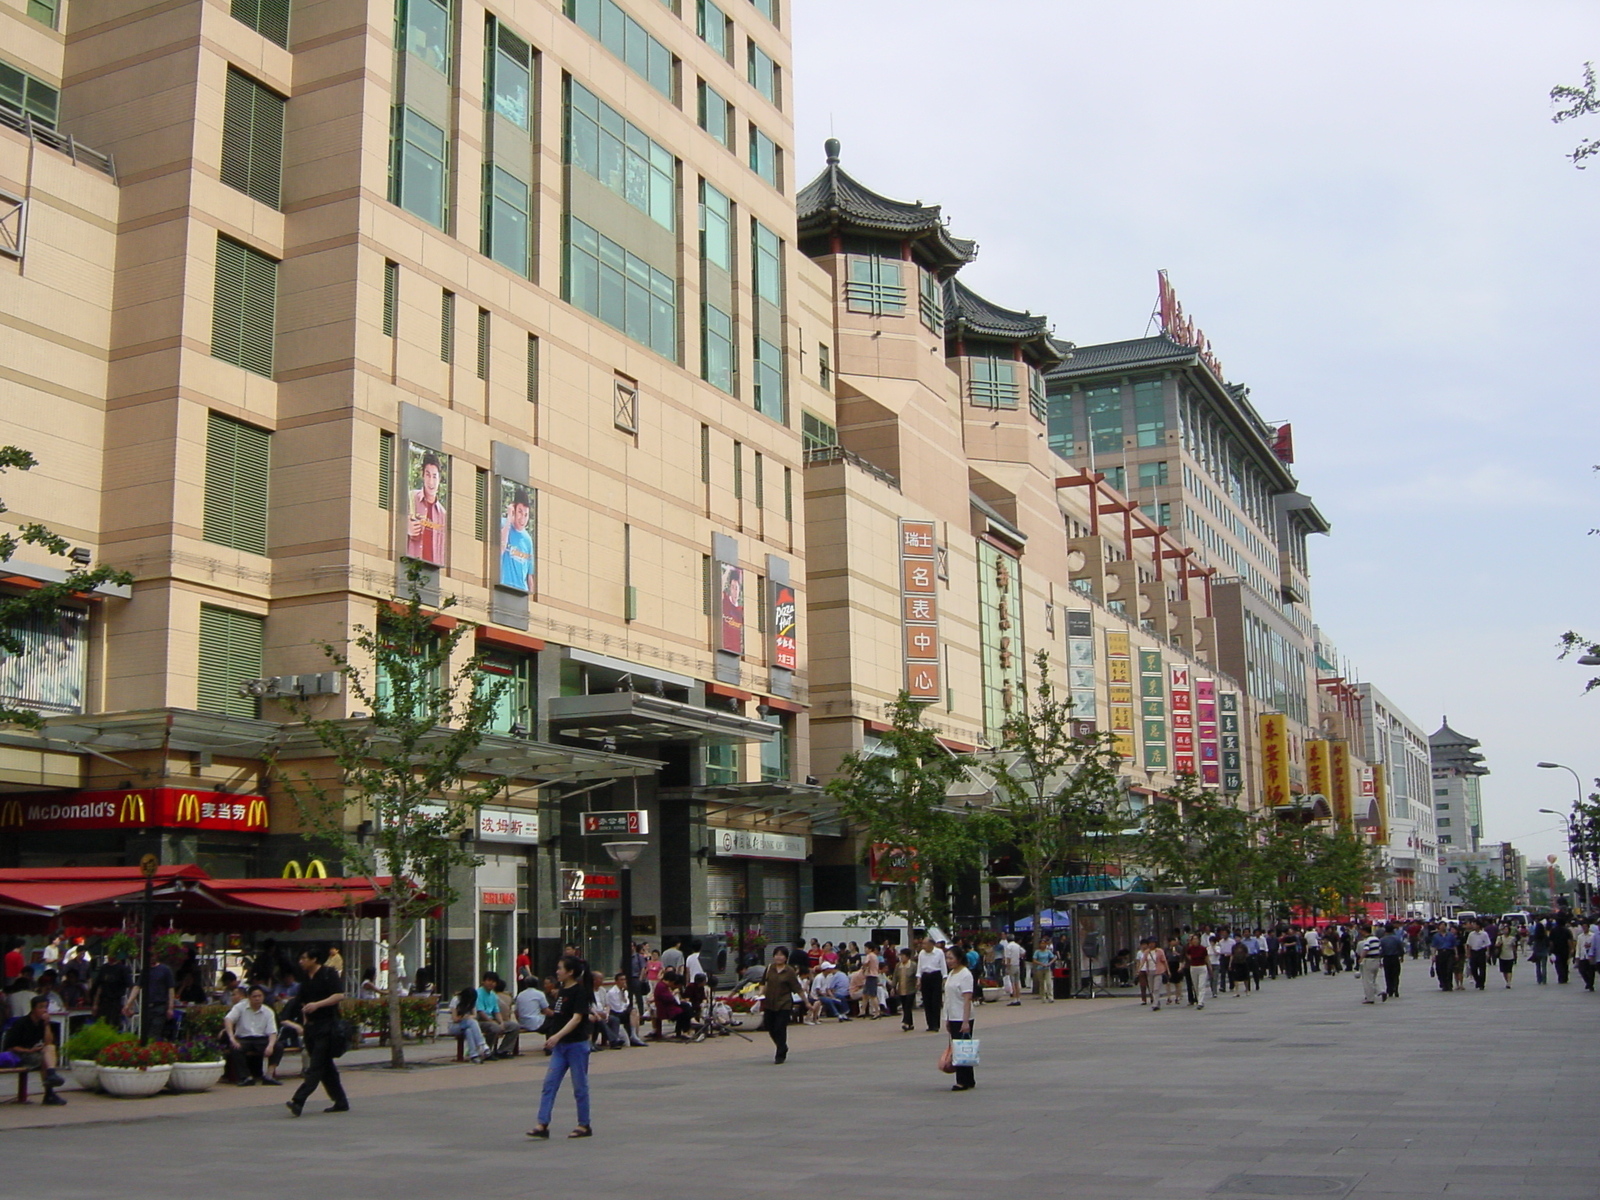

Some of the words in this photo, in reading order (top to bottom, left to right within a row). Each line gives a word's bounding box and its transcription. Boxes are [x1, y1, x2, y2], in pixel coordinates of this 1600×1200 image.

[904, 532, 933, 690] 瑞士名表中心
[28, 802, 115, 819] McDonald's
[202, 803, 246, 820] 麦当劳
[481, 817, 523, 835] 波姆斯
[630, 816, 638, 829] 2
